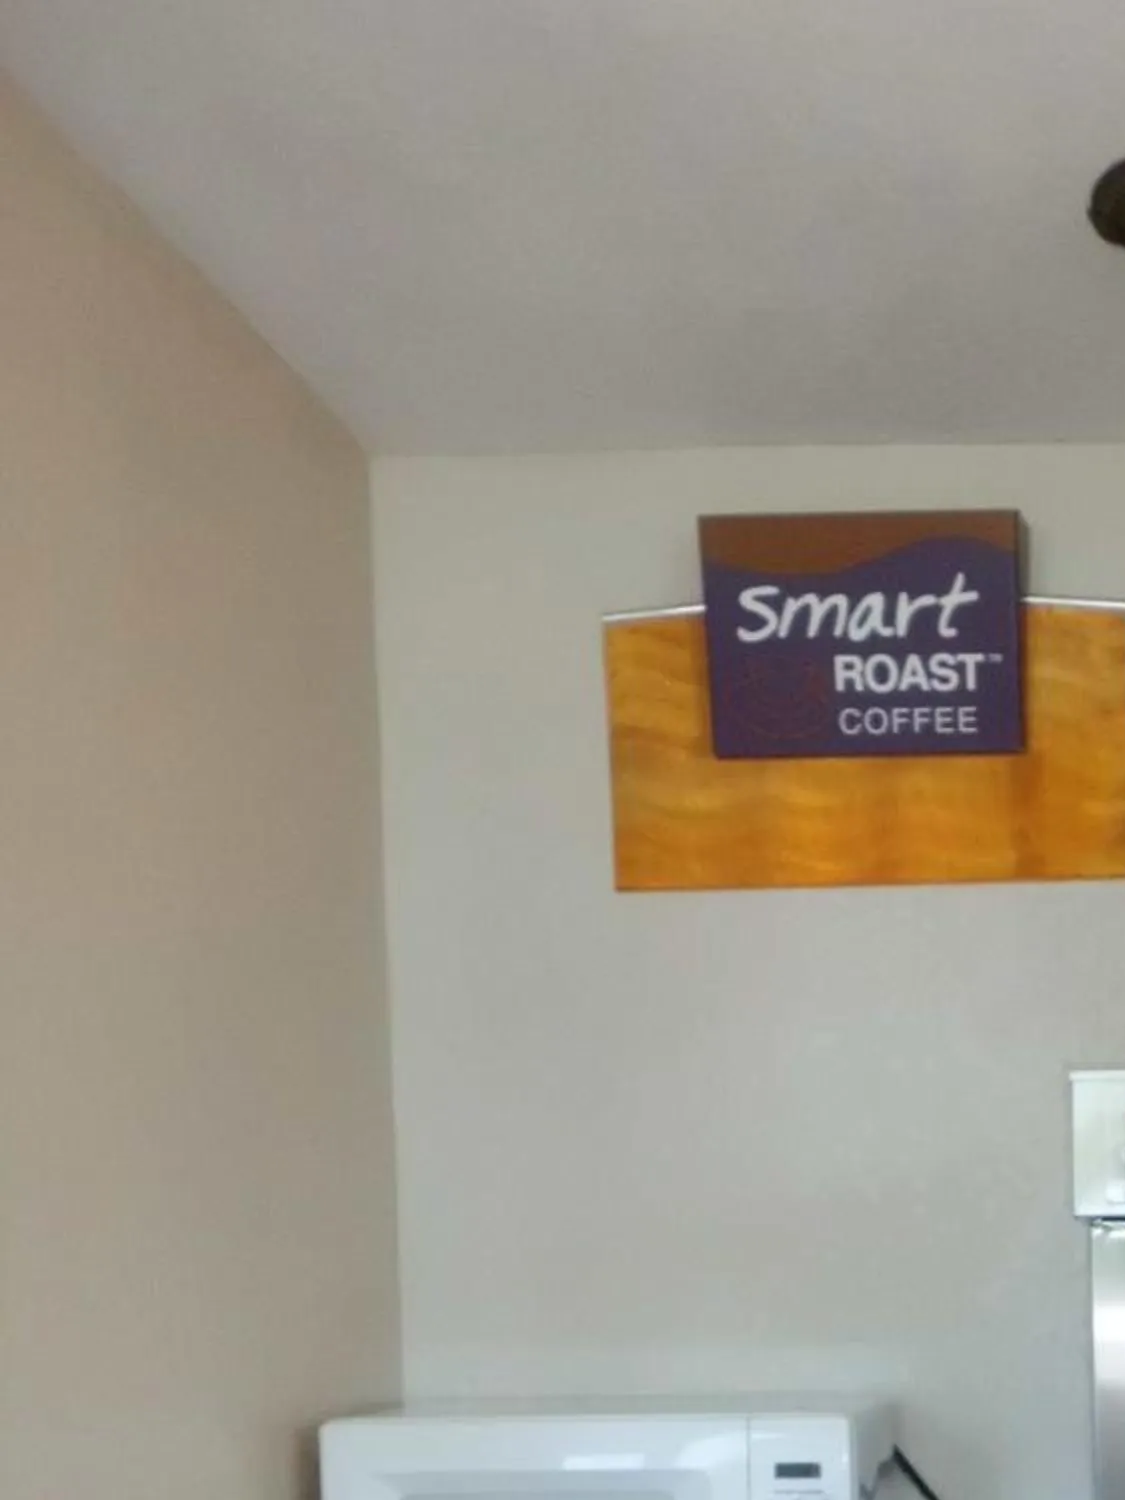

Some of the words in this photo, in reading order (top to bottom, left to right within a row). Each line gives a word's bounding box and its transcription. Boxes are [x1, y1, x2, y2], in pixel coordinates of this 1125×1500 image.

[736, 572, 979, 642] Smart
[833, 653, 984, 692] ROAST
[838, 706, 979, 735] COFFEE
